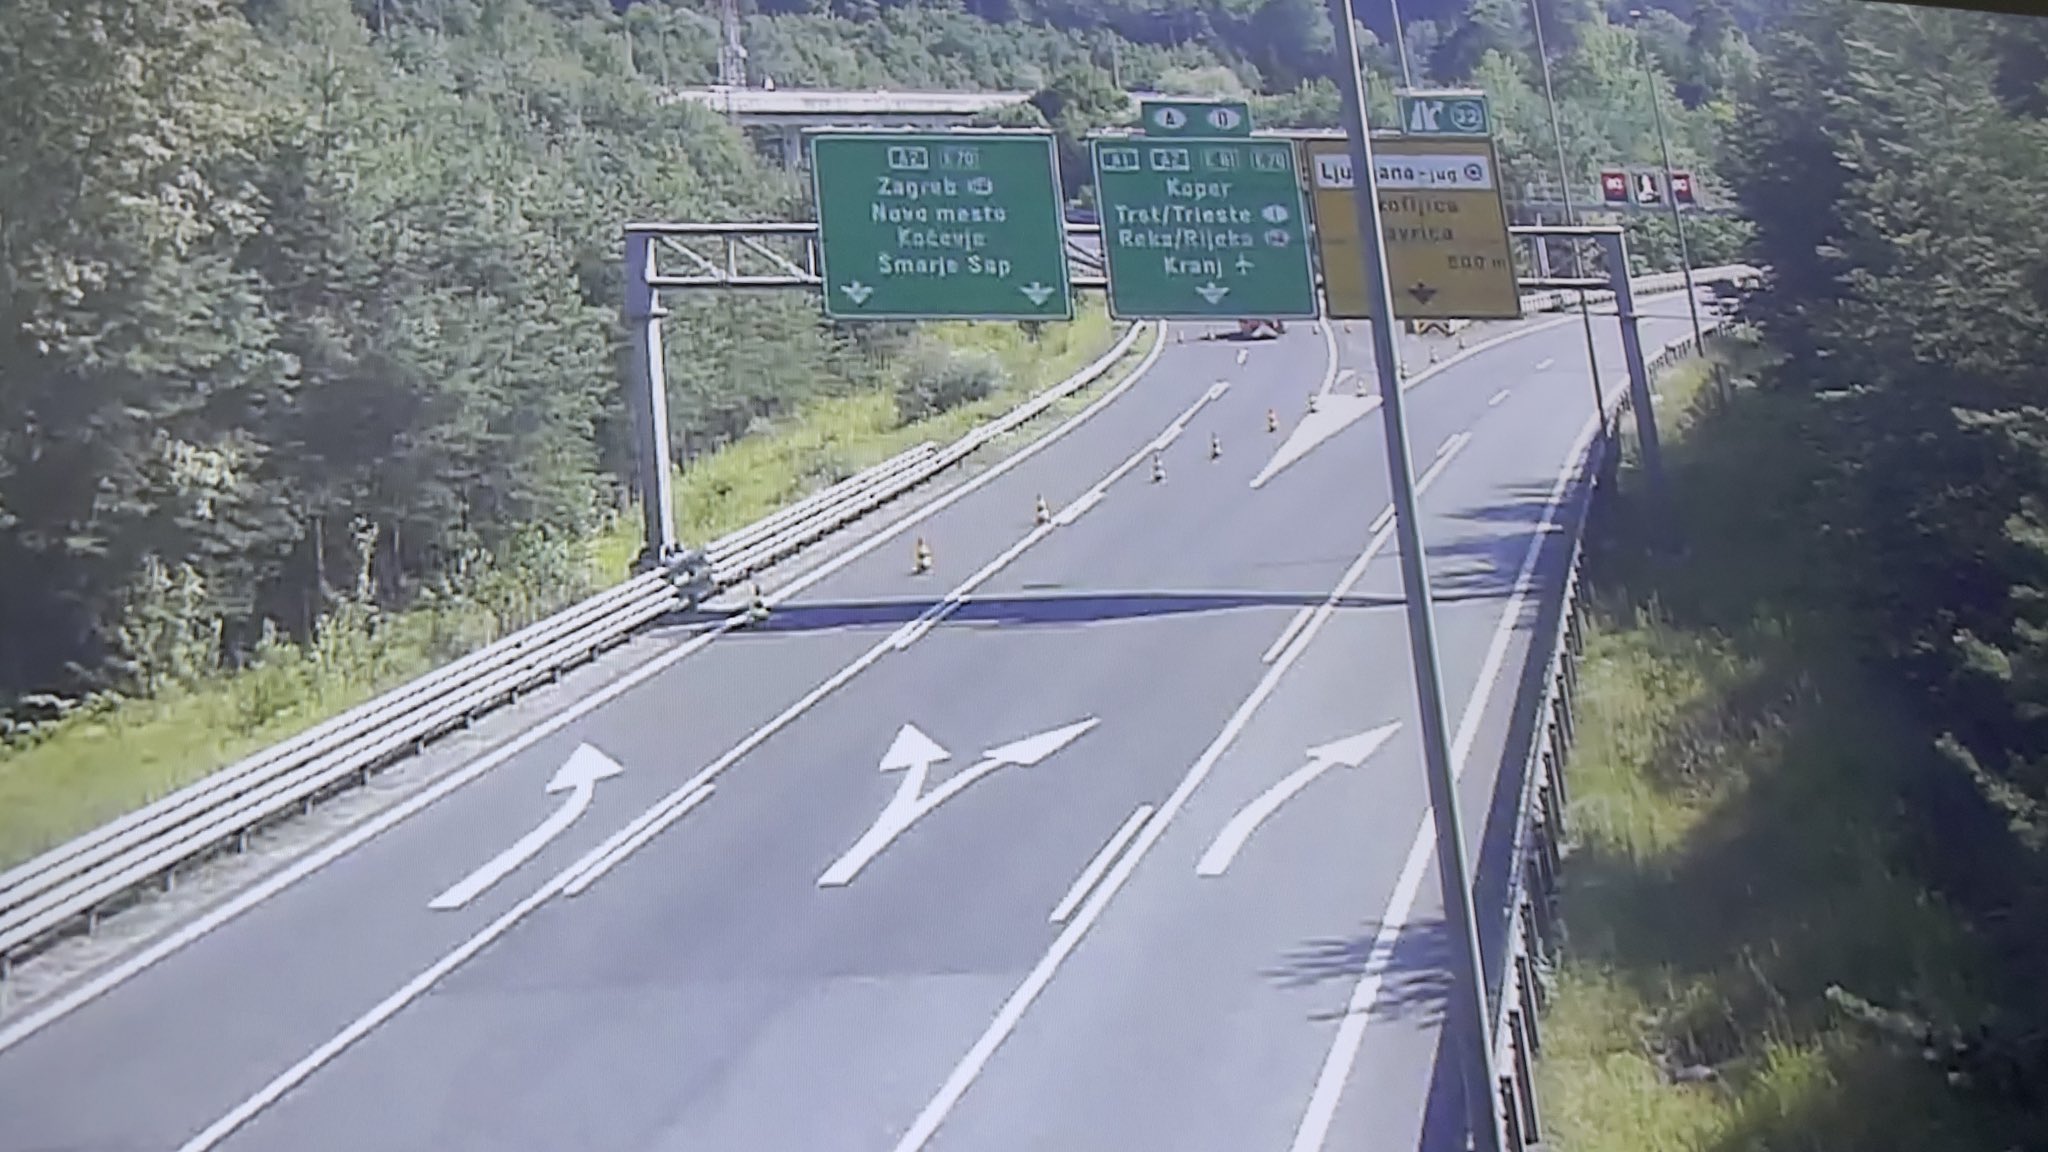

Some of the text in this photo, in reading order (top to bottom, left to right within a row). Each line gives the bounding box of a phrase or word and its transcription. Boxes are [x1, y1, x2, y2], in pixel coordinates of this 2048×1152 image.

[1166, 111, 1175, 125] A
[1321, 162, 1457, 183] Ljujana-jug
[878, 176, 957, 200] Zagreb
[1166, 177, 1233, 200] Koper
[872, 202, 1006, 222] Novo mesto
[967, 254, 1011, 277] Sap
[1164, 256, 1222, 279] Kranj
